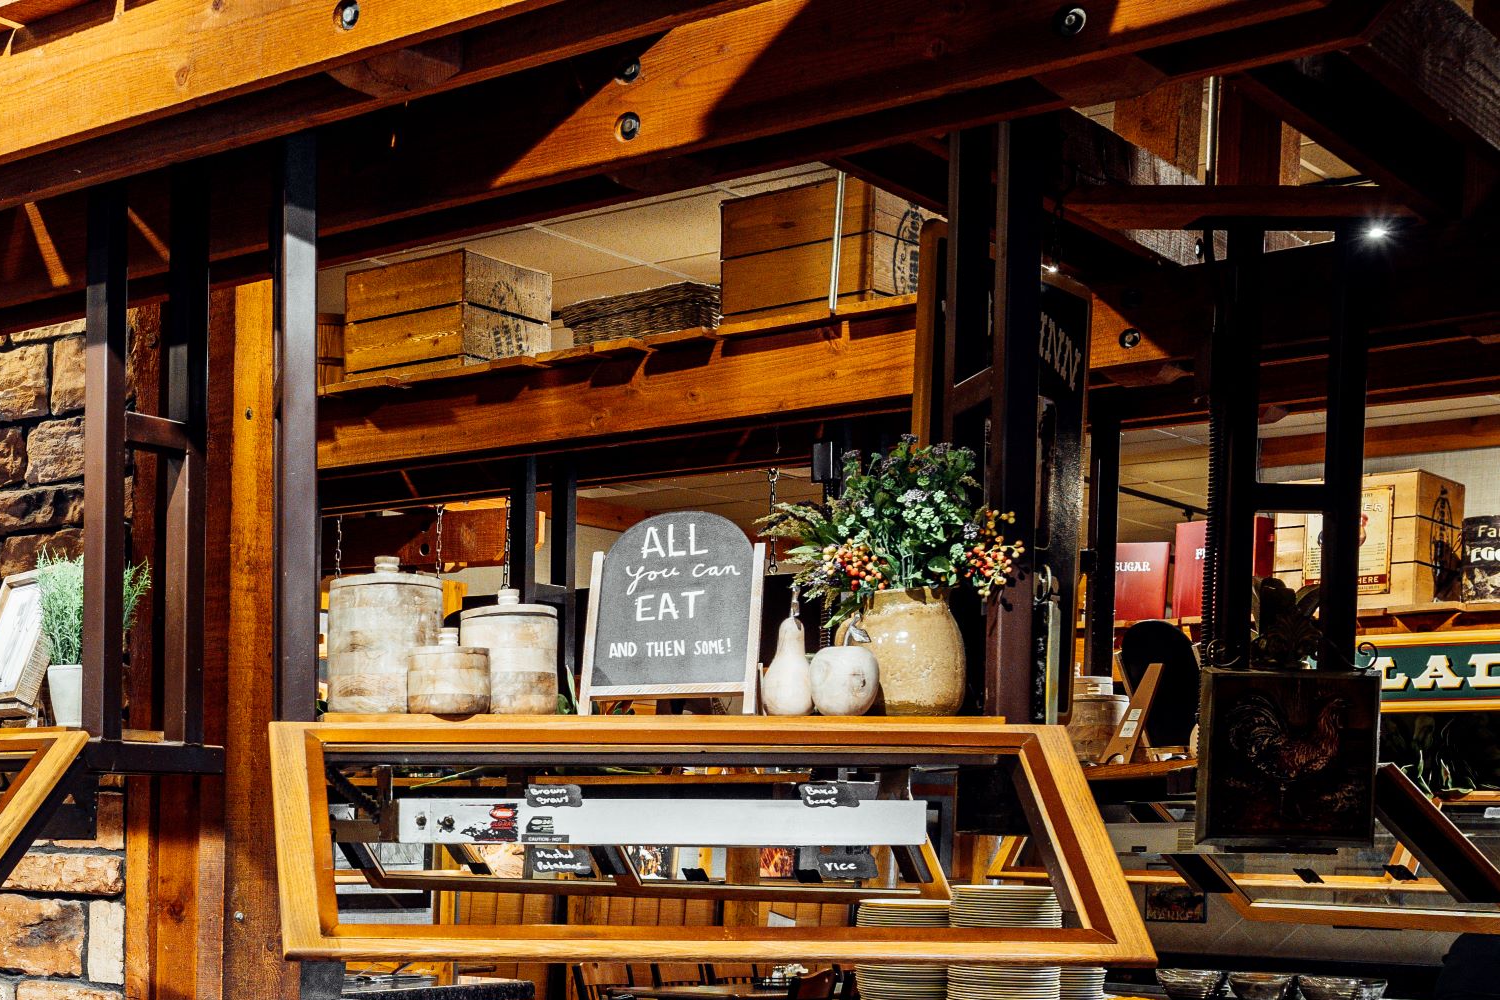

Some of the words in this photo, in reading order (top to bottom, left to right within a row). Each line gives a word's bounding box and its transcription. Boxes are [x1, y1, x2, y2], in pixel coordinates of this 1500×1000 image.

[641, 523, 709, 558] ALL
[1478, 524, 1500, 537] Fa
[1115, 561, 1151, 572] SUGAR
[634, 590, 705, 622] EAT
[609, 641, 638, 659] AND
[646, 640, 685, 657] THEN
[693, 637, 732, 656] SOME!
[1368, 653, 1500, 689] LAD
